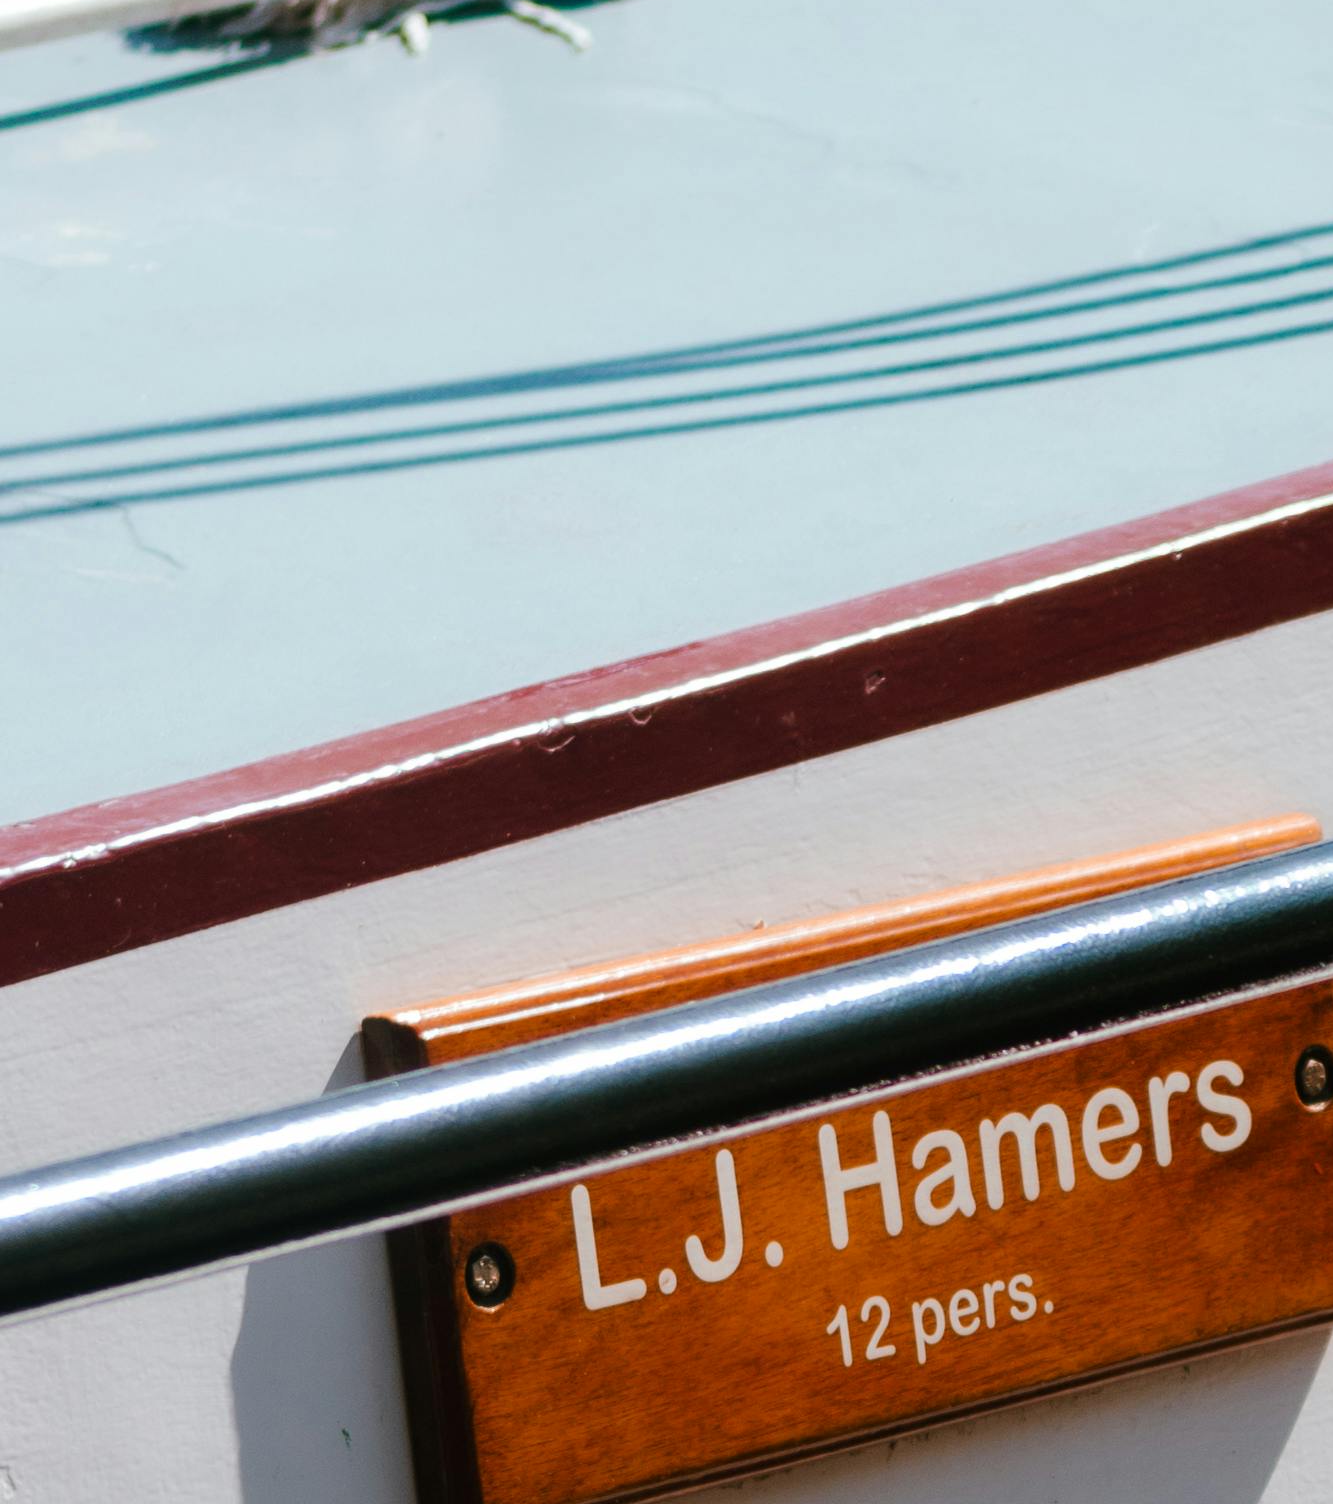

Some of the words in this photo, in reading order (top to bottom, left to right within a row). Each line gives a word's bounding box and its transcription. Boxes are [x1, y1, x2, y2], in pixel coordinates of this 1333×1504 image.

[570, 1147, 785, 1311] L.J.
[818, 1059, 1253, 1251] Hamers
[826, 1295, 896, 1367] 12
[912, 1273, 1055, 1365] pers.
